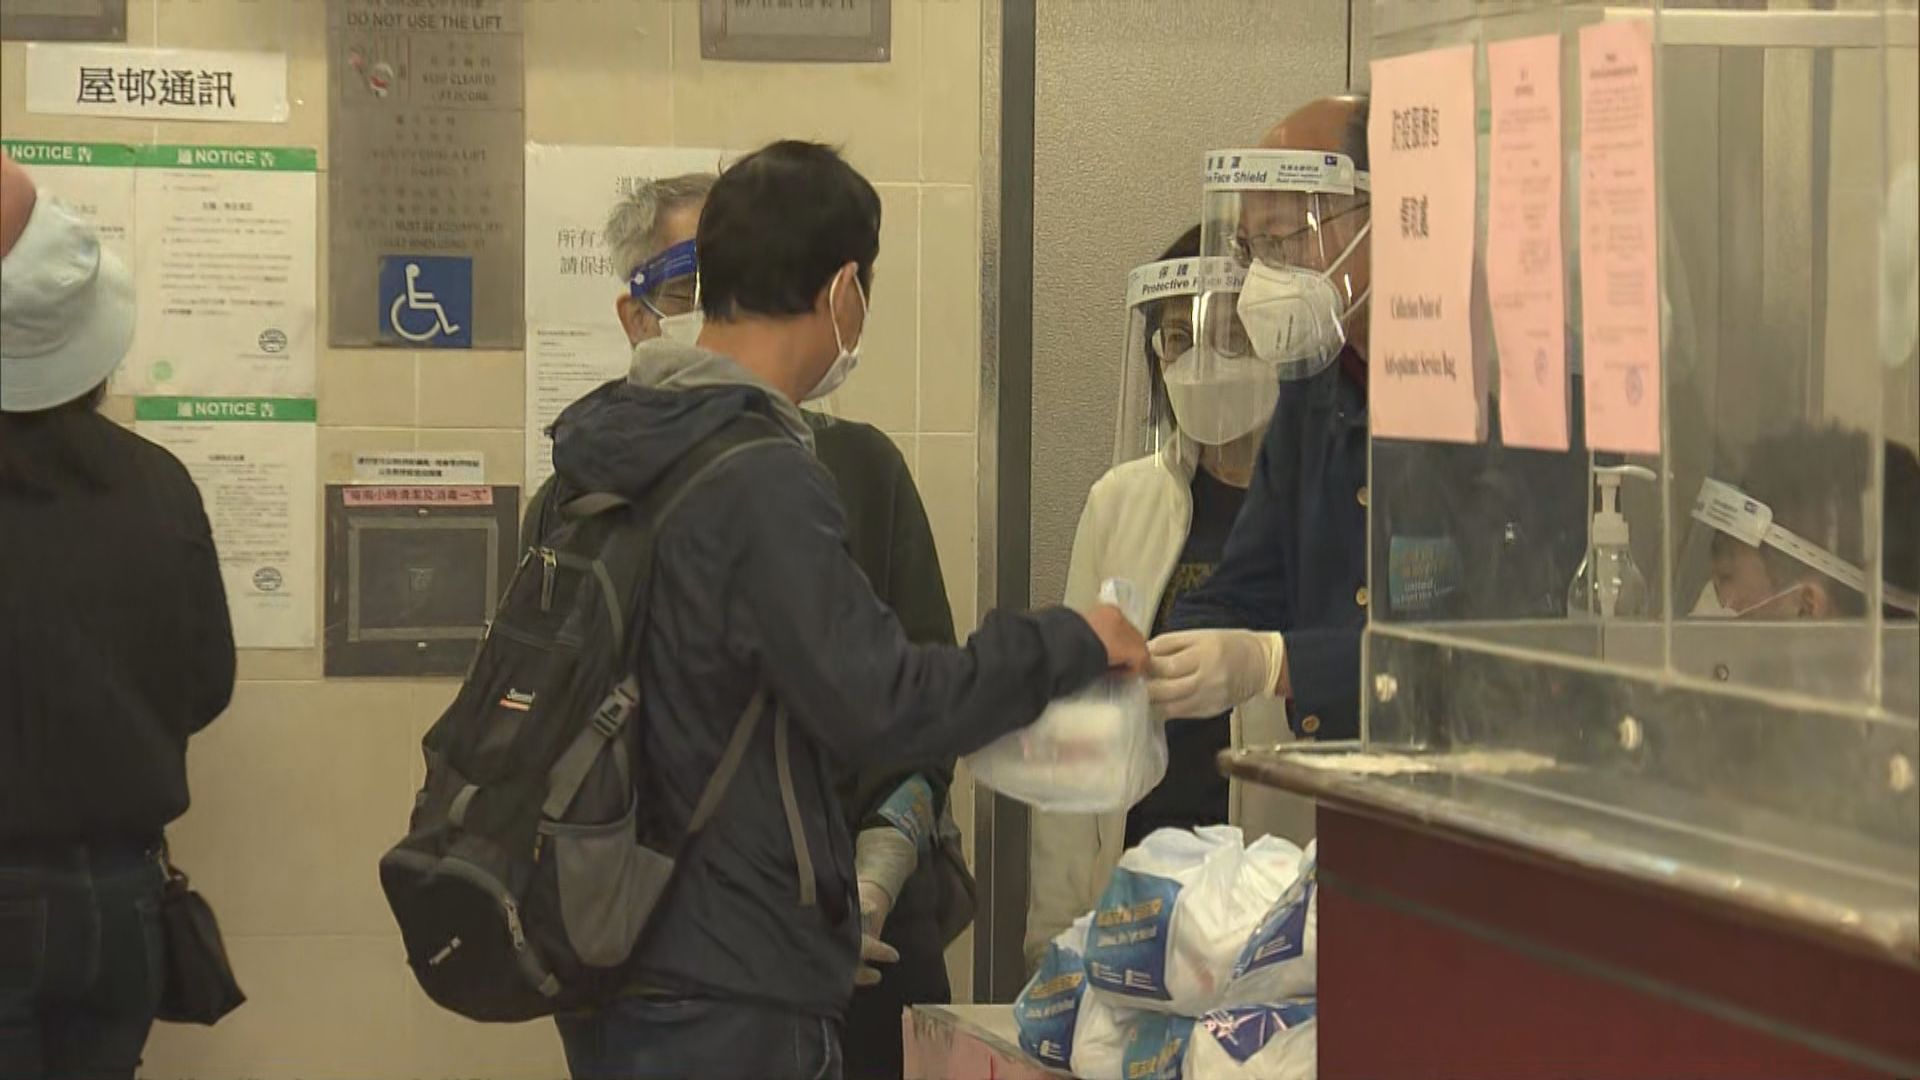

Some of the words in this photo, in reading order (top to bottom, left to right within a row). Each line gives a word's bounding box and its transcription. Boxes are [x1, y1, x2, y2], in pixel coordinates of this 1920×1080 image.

[346, 12, 369, 26] DO
[372, 13, 402, 27] NOT
[407, 15, 438, 30] USE
[441, 16, 470, 30] THE
[472, 16, 503, 30] LIFT
[76, 66, 236, 108] 屋邨通訊
[11, 145, 73, 160] NOTICE
[194, 149, 256, 165] NOTICE
[1233, 170, 1267, 184] Shield
[1142, 277, 1190, 296] Protective
[195, 402, 257, 416] NOTICE
